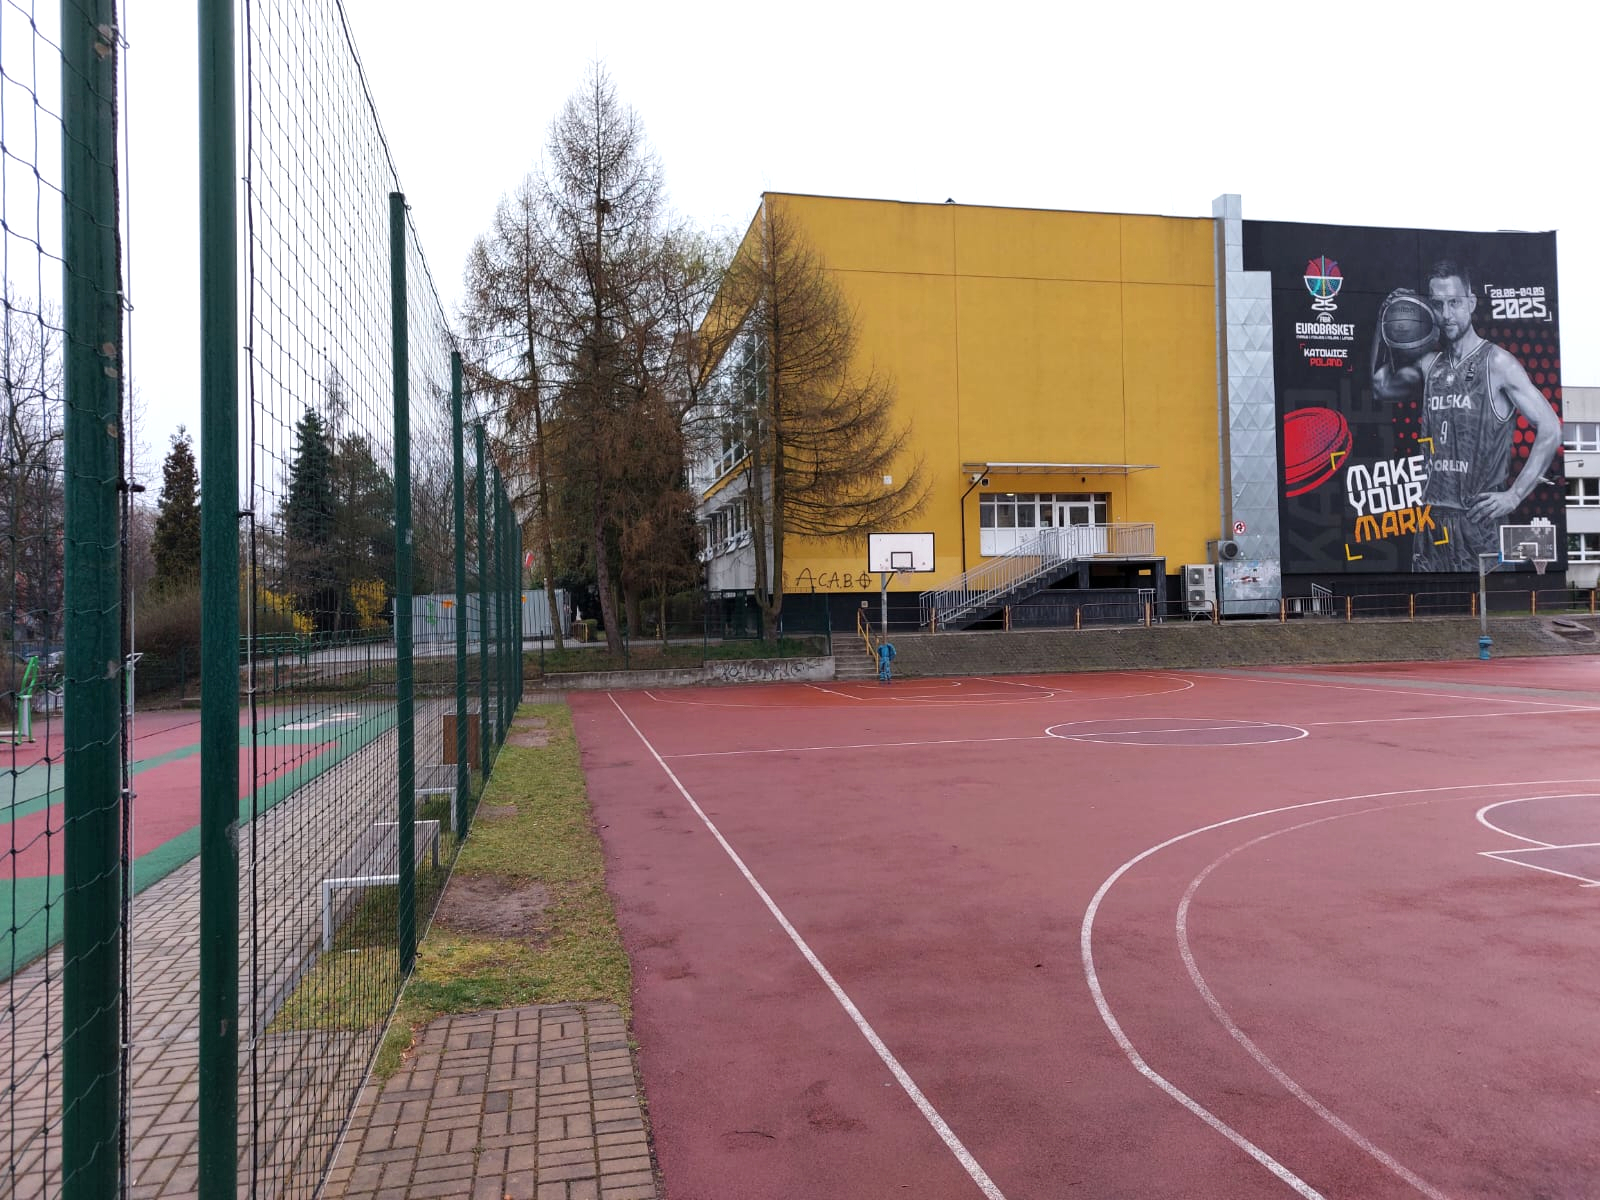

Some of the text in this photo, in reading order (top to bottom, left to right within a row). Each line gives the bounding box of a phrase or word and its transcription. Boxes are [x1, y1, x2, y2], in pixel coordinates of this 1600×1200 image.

[1491, 297, 1547, 319] 2025
[1295, 322, 1355, 336] EUROBASKET
[1303, 348, 1348, 358] KATOWICE
[1309, 358, 1343, 367] POLAND
[1440, 420, 1448, 444] 9
[1346, 454, 1428, 493] MAKE
[1434, 459, 1469, 474] ORLEN
[1348, 481, 1423, 516] YOUR
[1355, 502, 1436, 544] MARK
